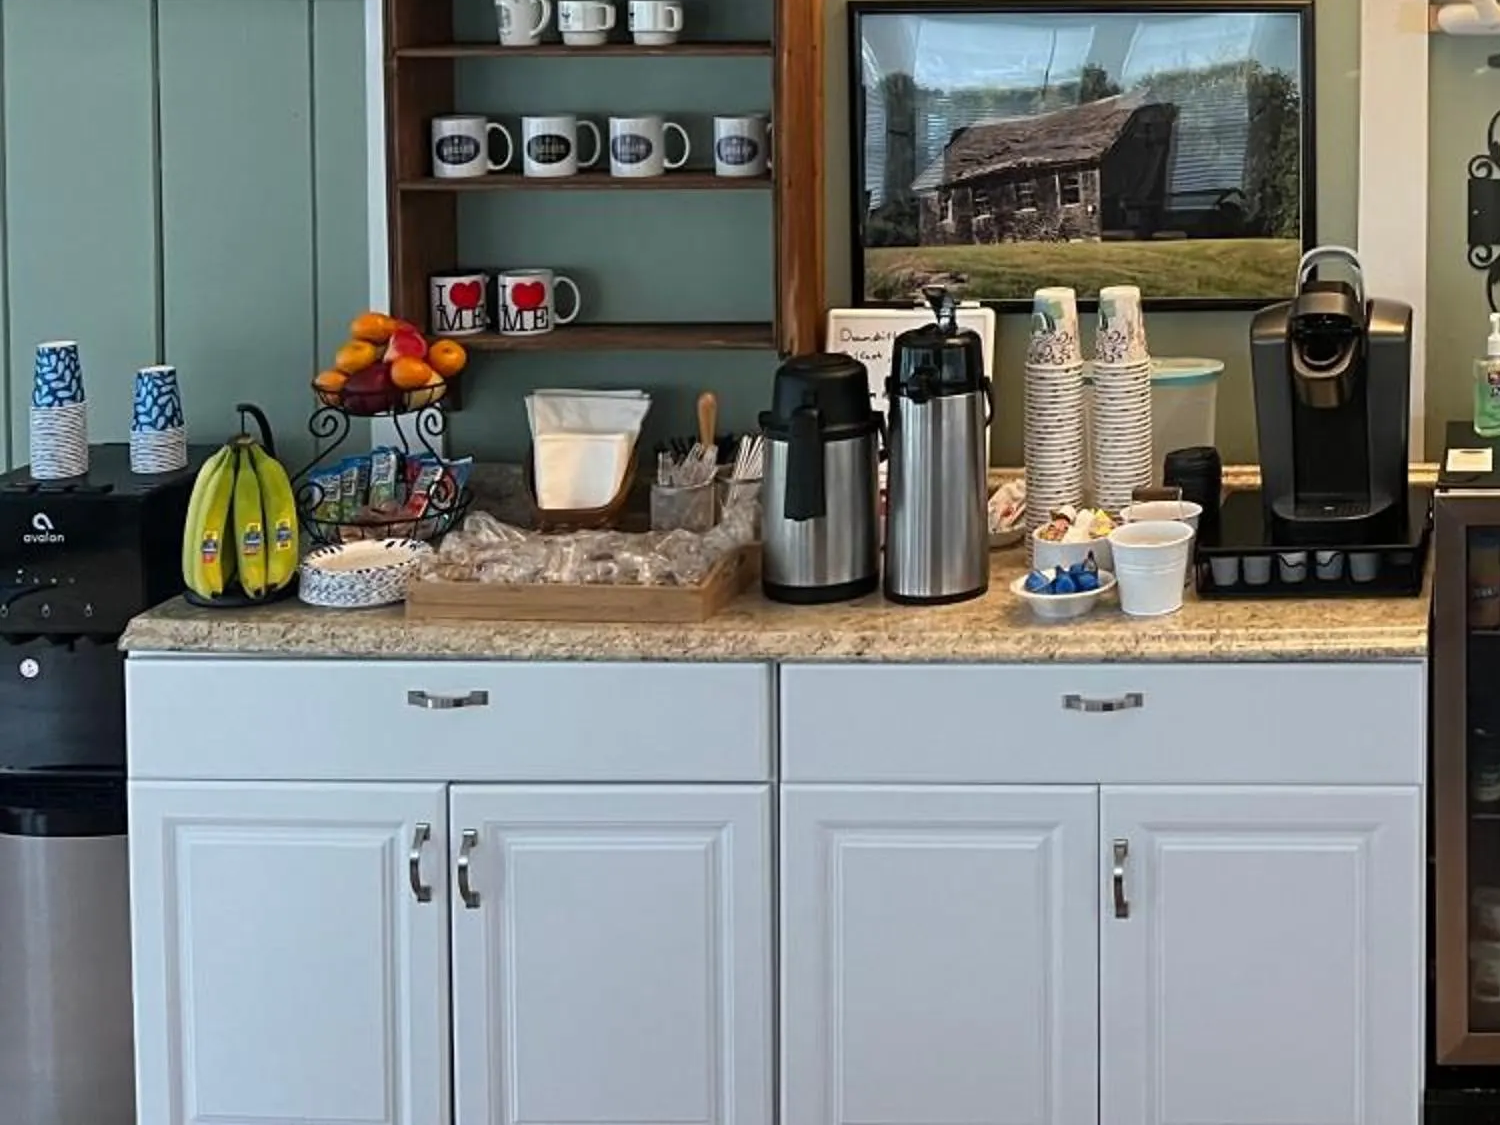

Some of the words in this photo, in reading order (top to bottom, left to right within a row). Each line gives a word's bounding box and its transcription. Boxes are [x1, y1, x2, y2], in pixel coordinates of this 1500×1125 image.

[435, 284, 446, 307] I
[500, 284, 508, 307] I
[436, 305, 485, 332] ME
[501, 305, 549, 332] ME
[23, 530, 65, 543] avalon
